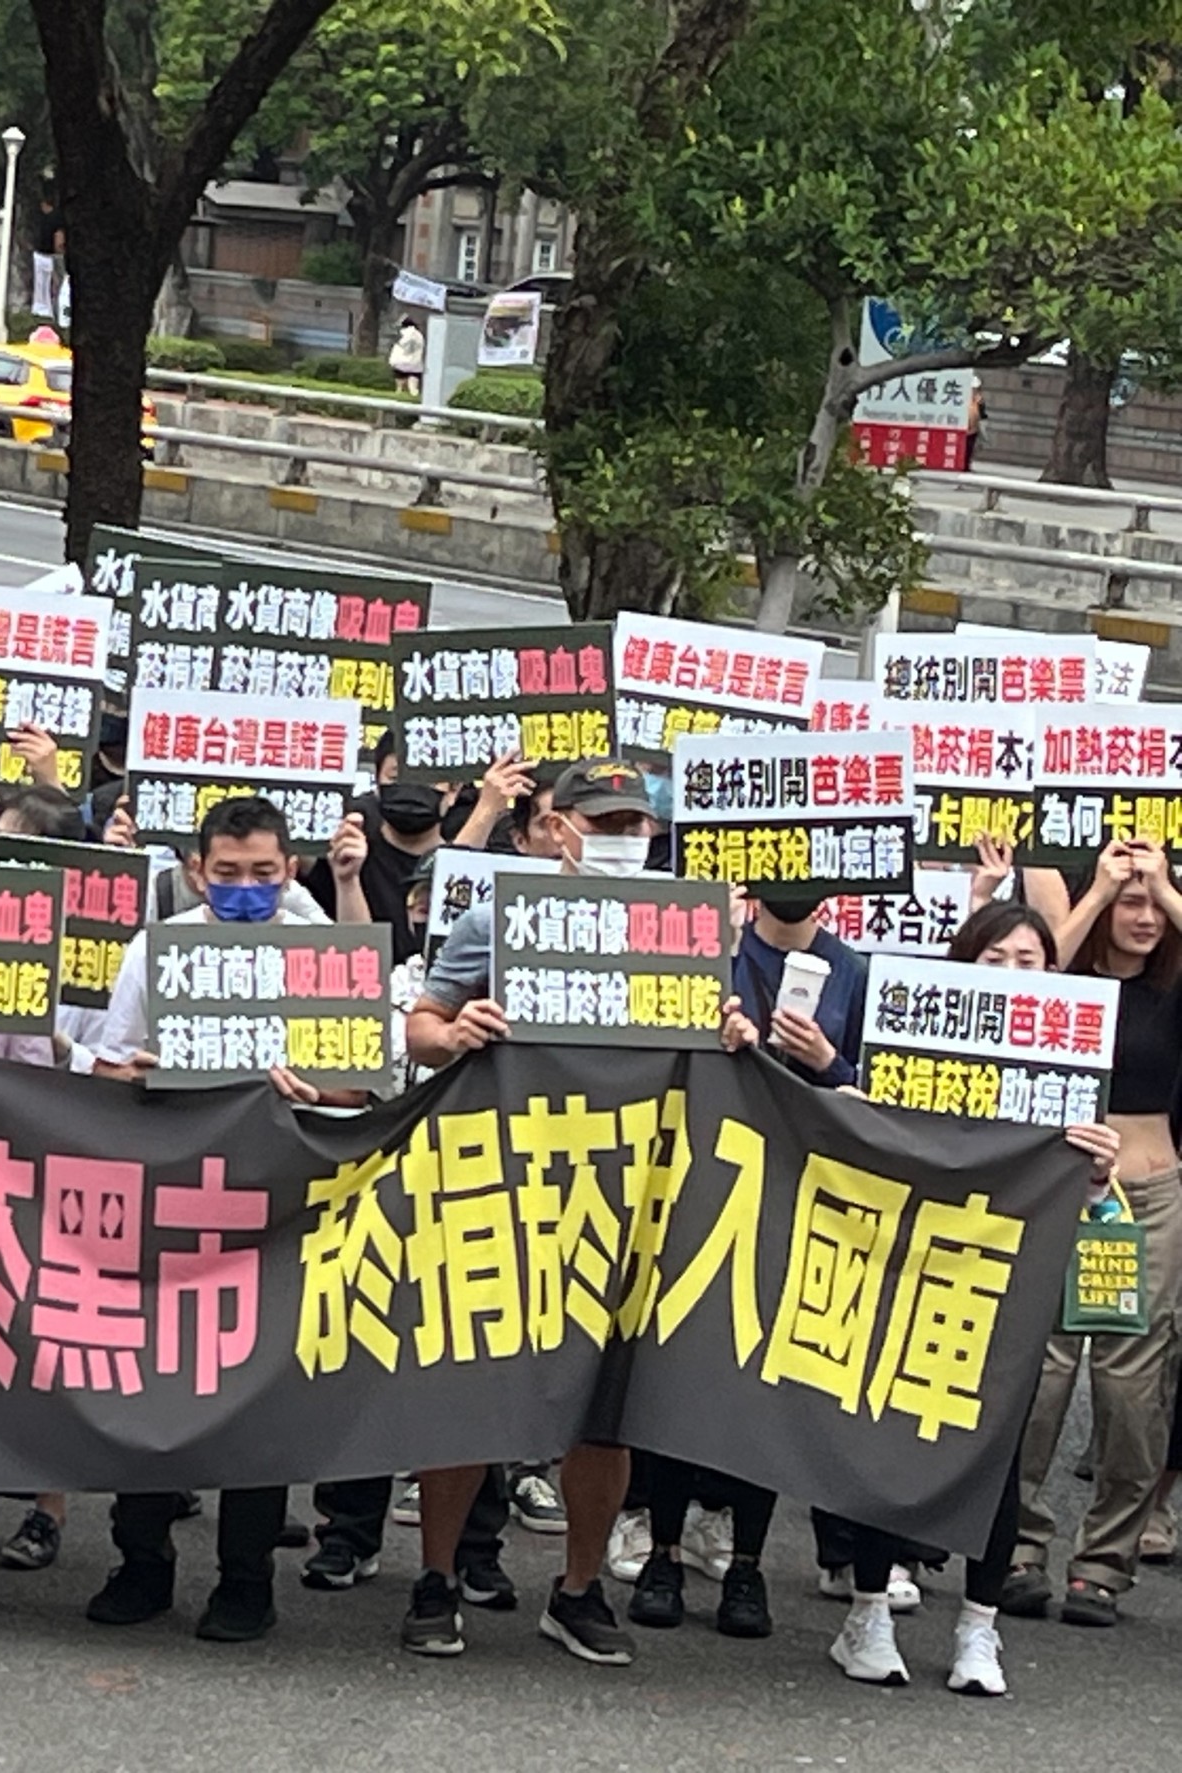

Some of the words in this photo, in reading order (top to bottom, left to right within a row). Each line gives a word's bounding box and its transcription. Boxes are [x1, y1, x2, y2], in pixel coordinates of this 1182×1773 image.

[225, 581, 421, 645] 水貨商像吸血鬼
[402, 645, 607, 700] 水貨商像吸血鬼
[622, 635, 809, 706] 健康台灣是謊言
[883, 655, 1086, 703] 總統別開芭樂票
[143, 712, 348, 772] 健康台灣是謊言
[404, 709, 610, 768] 菸捐菸稅吸到乾
[684, 754, 904, 811] 總統別開芭樂票
[684, 826, 905, 882] 菸捐菸稅助癌篩
[504, 895, 721, 958] 水貨商像吸血鬼
[157, 945, 383, 1000] 水貨商像吸血鬼
[504, 966, 721, 1029] 菸捐菸稅吸到乾
[157, 1015, 384, 1071] 菸捐菸稅吸到乾
[875, 979, 1105, 1056] 總統別開芭樂票
[869, 1051, 1101, 1128] 菸捐菸稅助癌篩
[294, 1089, 1025, 1443] 菸捐菸稅入國庫
